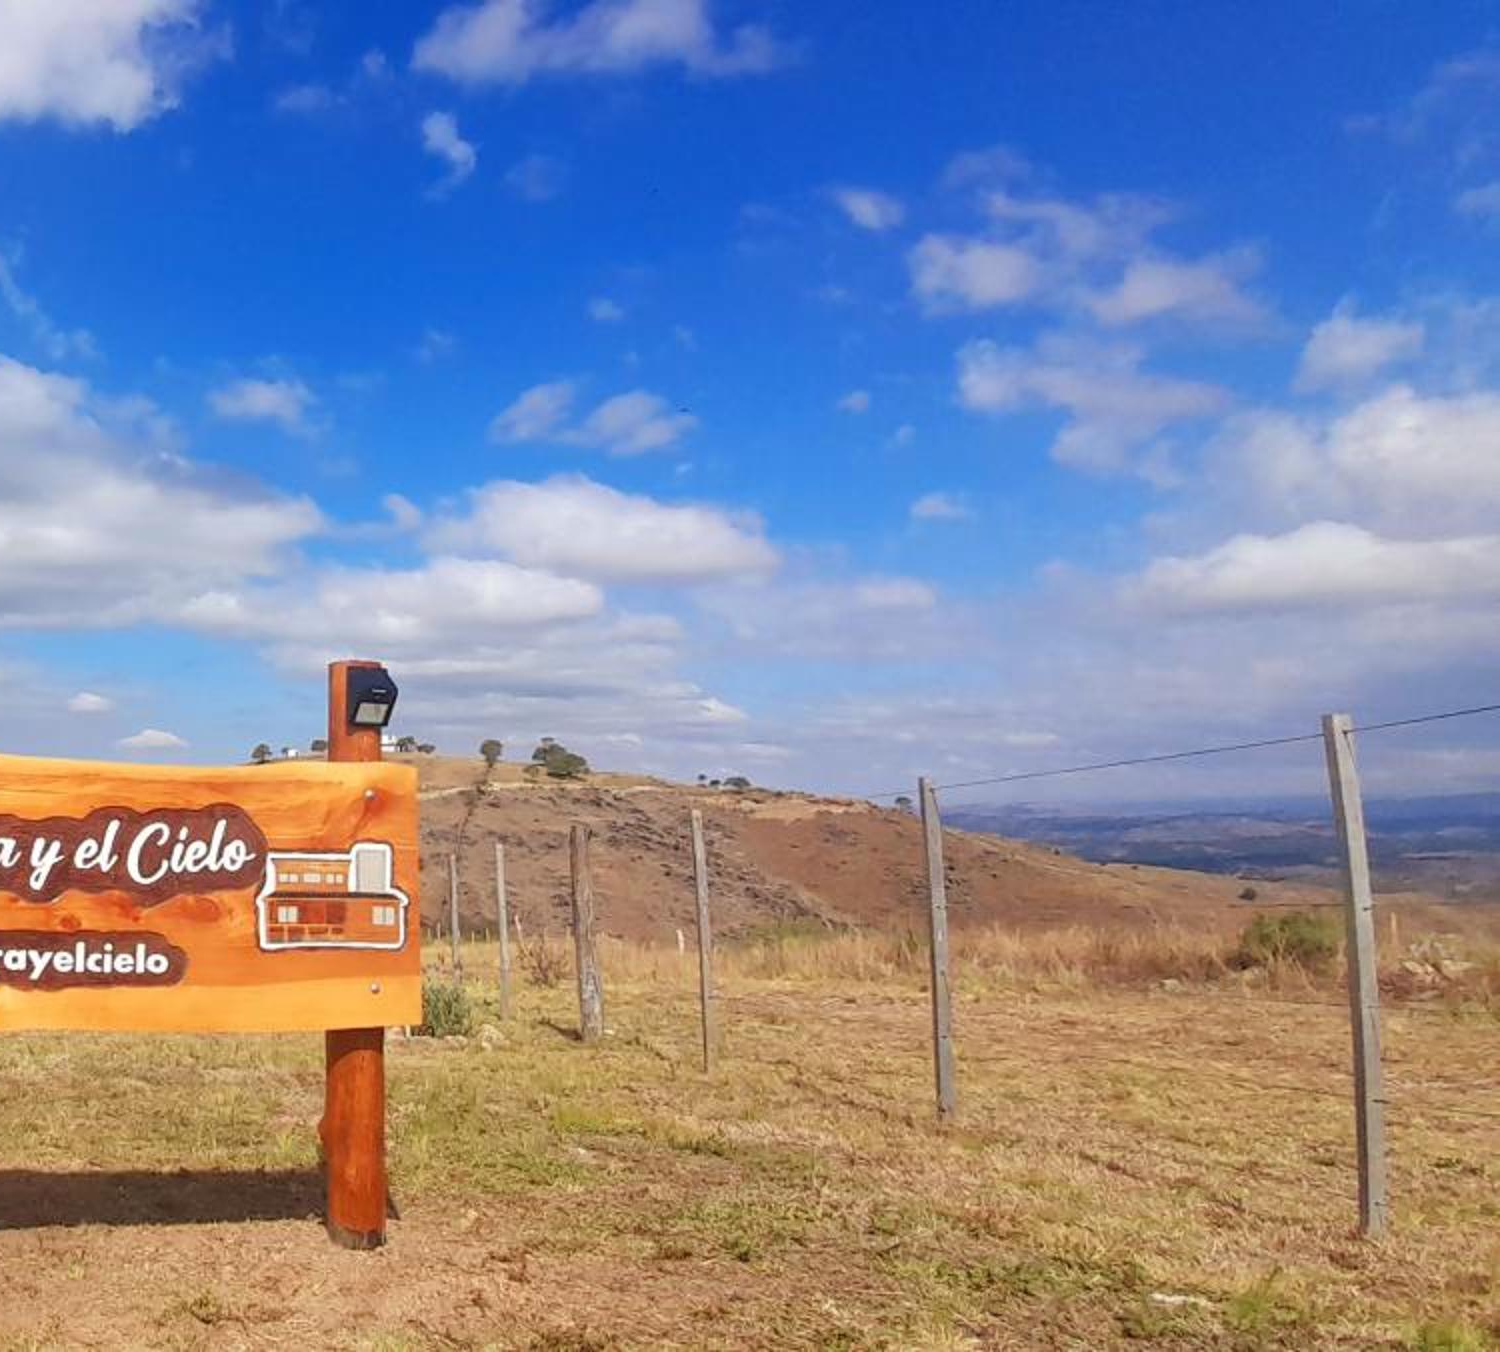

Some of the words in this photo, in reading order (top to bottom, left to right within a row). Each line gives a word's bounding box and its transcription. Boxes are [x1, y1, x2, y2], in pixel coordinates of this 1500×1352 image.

[29, 837, 65, 891] y
[74, 819, 120, 873] el
[126, 819, 256, 885] Cielo
